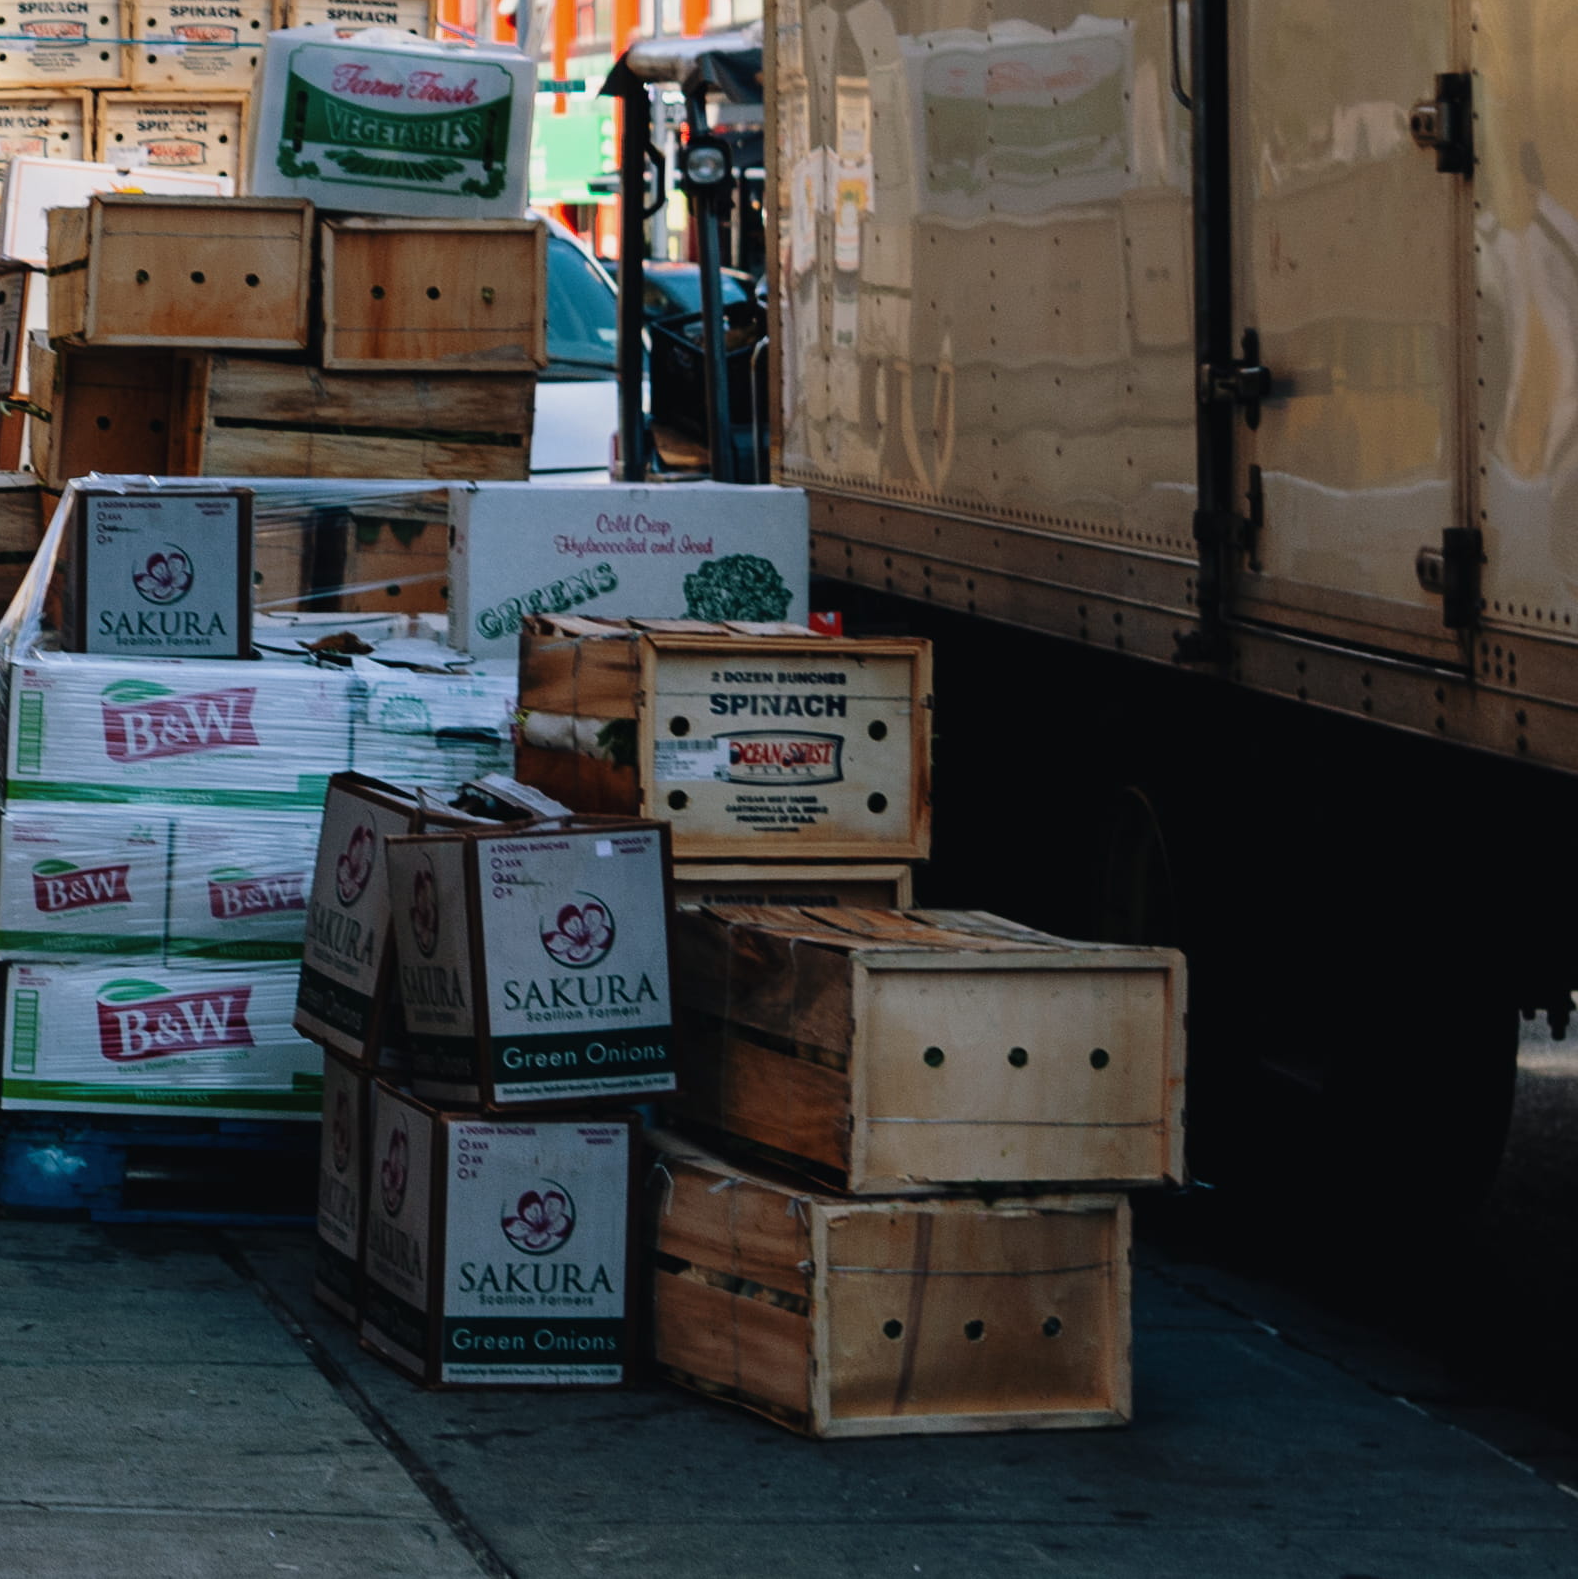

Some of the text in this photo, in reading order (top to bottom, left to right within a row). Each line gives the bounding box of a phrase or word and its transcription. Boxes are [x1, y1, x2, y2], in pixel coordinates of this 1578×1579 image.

[17, 2, 89, 15] SPINACH
[170, 5, 242, 18] SPINACH
[327, 8, 399, 24] SPINACH
[331, 62, 404, 99] Farm
[325, 97, 482, 152] VEGETABLES
[596, 513, 672, 538] Cold Crisp
[650, 536, 675, 554] and
[475, 561, 620, 640] GREENS
[99, 609, 228, 638] SAKURA
[724, 671, 773, 684] DOZEN
[777, 671, 847, 685] BUNCHES
[709, 693, 848, 718] SPINACH
[120, 695, 237, 757] B&W
[729, 741, 786, 767] OCEAN
[43, 870, 119, 910] B&W
[219, 878, 298, 917] B&W
[503, 972, 659, 1012] SAKURA
[113, 995, 235, 1057] B&W
[526, 1005, 642, 1023] Scallion Farmers
[501, 1040, 667, 1071] Green Onions
[457, 1261, 615, 1295] SAKURA
[479, 1294, 535, 1307] Scallion
[451, 1327, 618, 1351] Green Onions
